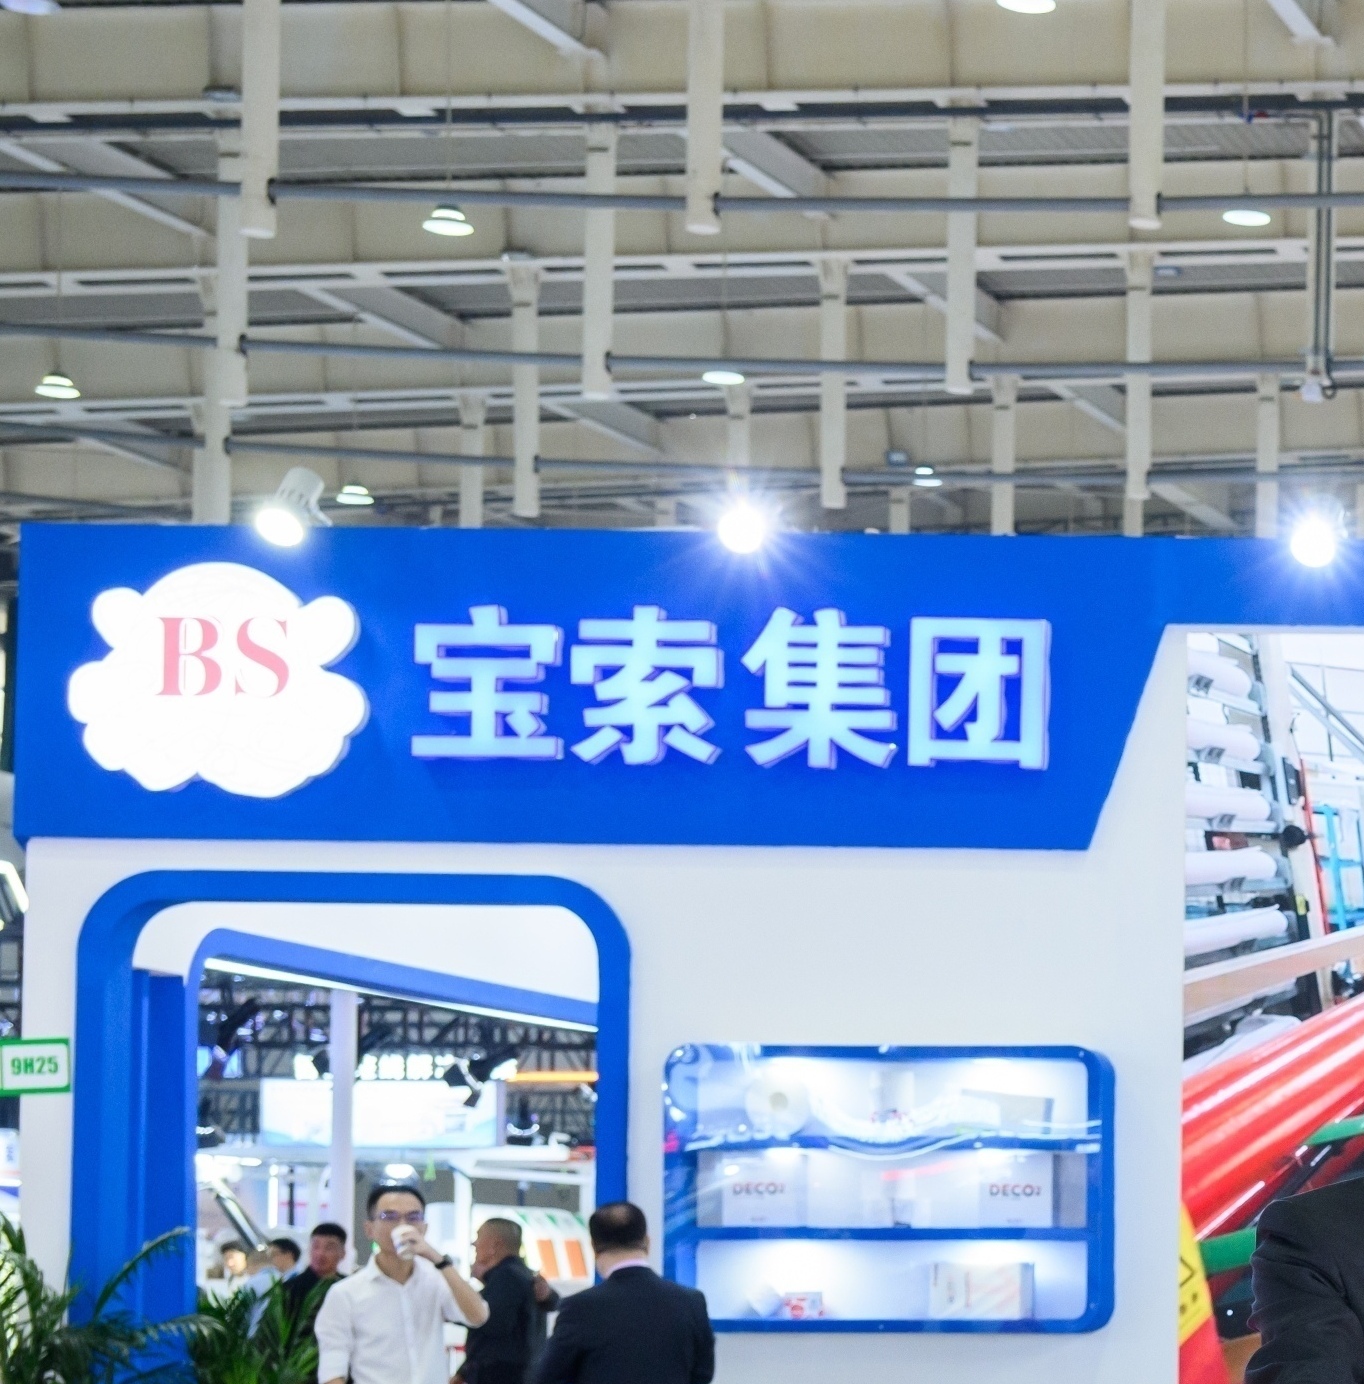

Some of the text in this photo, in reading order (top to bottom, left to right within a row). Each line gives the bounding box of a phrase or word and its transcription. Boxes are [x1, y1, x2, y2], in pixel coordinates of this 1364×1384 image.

[155, 615, 291, 698] BS
[411, 604, 1054, 772] 宝索集团
[10, 1056, 59, 1076] 9H25
